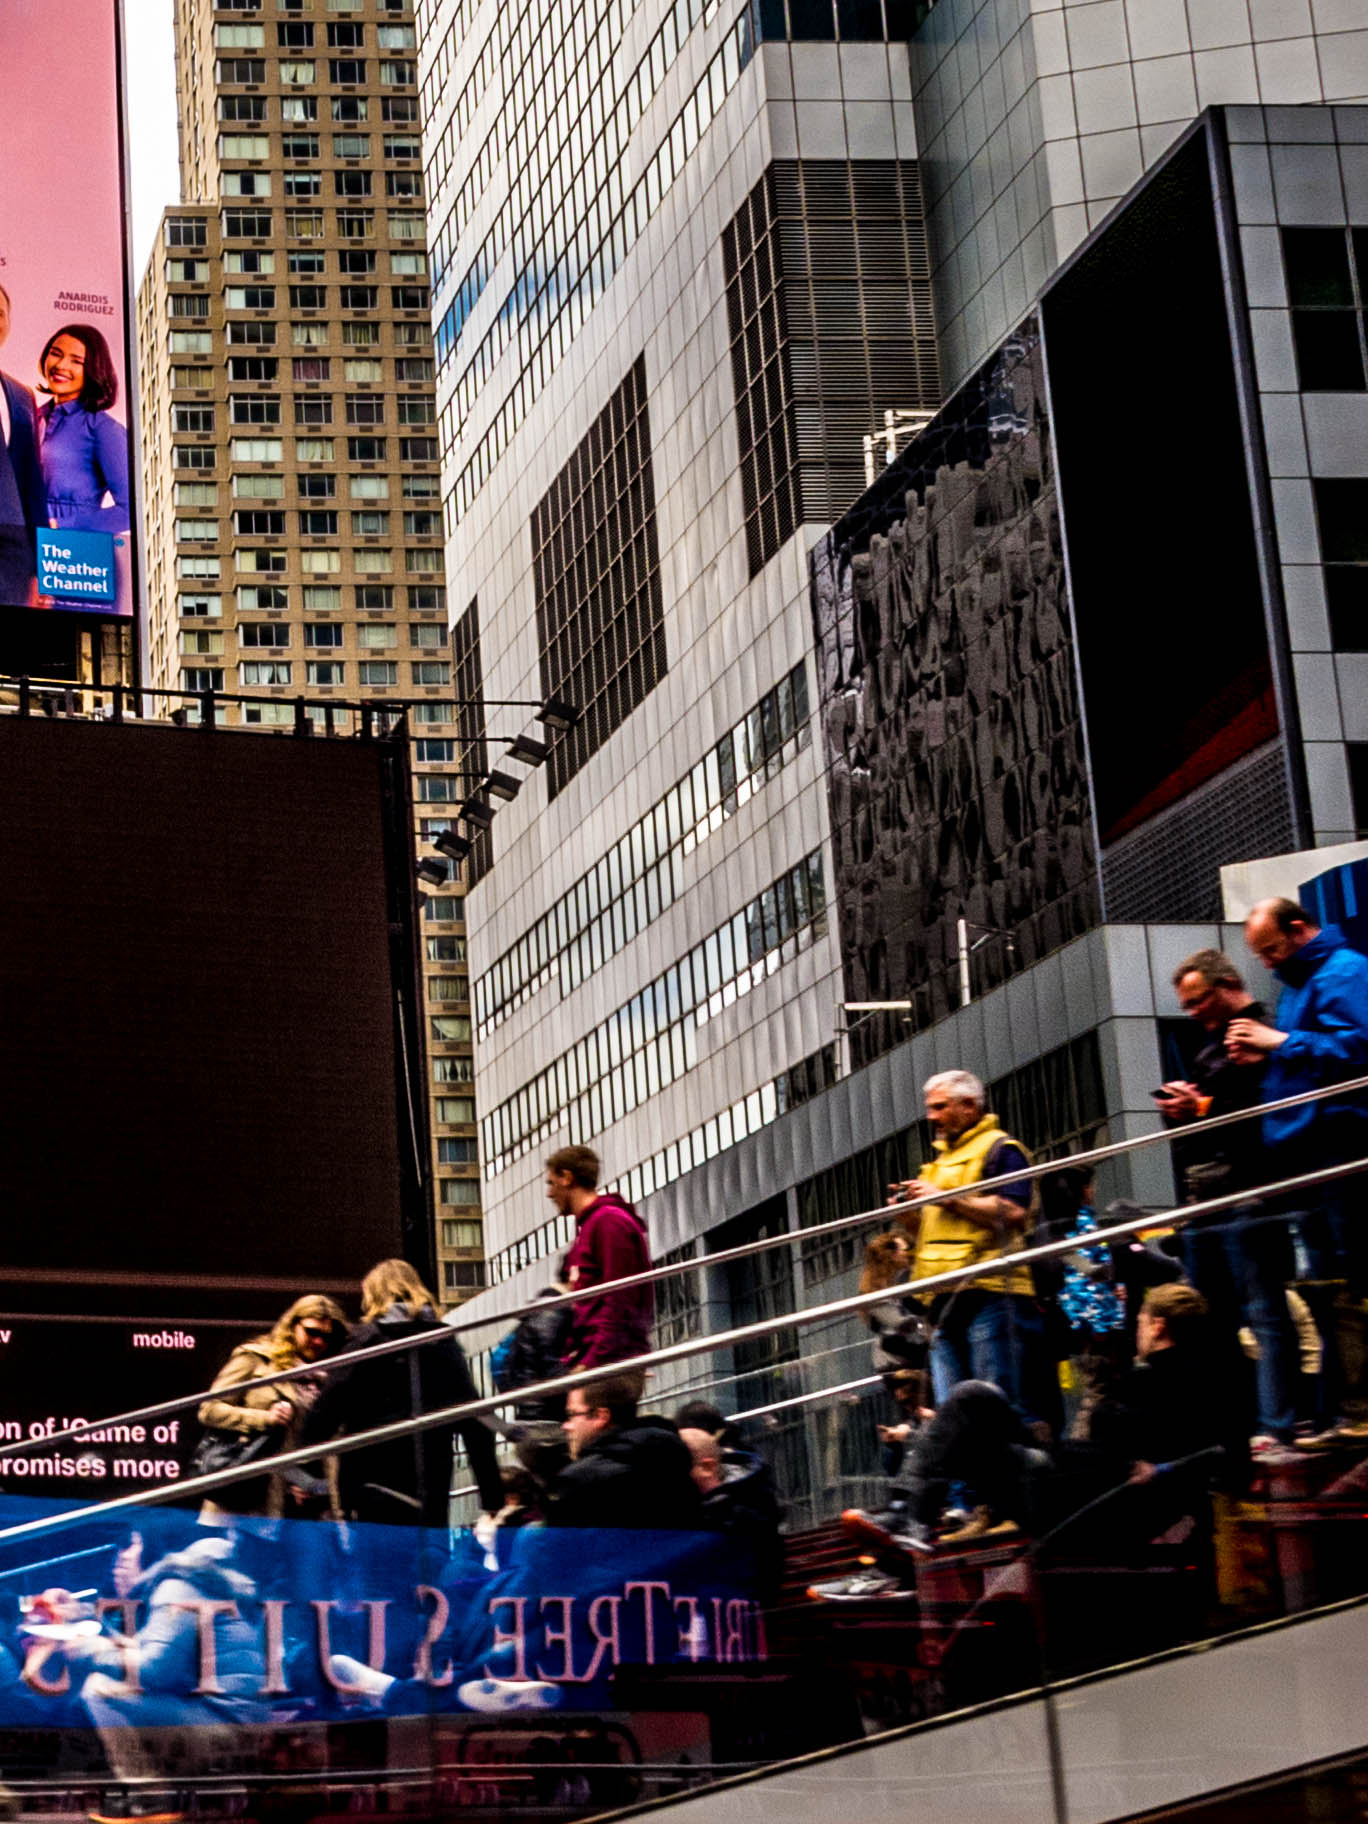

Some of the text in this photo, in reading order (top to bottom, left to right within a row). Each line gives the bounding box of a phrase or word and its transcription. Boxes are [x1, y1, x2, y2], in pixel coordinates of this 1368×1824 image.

[57, 290, 109, 305] ANARIDIS
[53, 299, 115, 316] RODRIGUEZ
[42, 544, 72, 559] The
[42, 559, 109, 578] Weather
[42, 575, 109, 593] Channel
[133, 1329, 195, 1350] mobile
[29, 1417, 56, 1441] of
[153, 1421, 179, 1444] of
[113, 1458, 180, 1479] more
